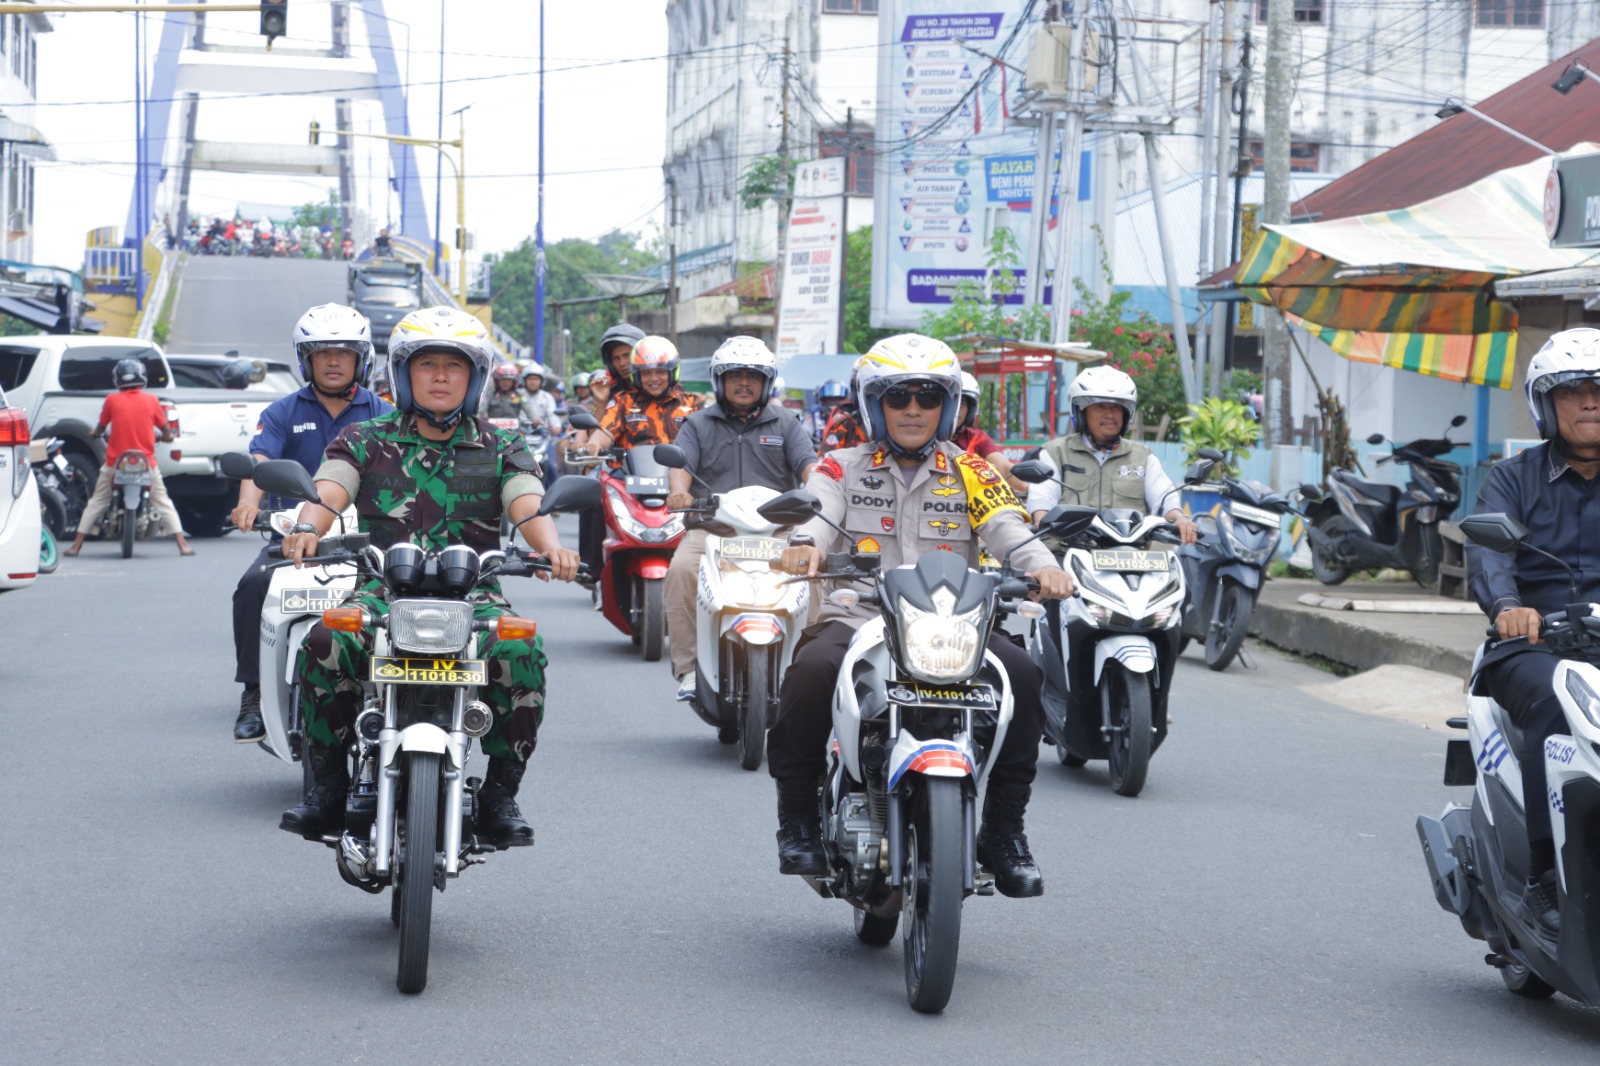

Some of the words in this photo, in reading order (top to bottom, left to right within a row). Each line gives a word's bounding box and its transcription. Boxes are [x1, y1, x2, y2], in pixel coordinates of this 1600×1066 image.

[990, 160, 1034, 174] BAYAR
[991, 176, 1012, 189] DEMI
[851, 495, 895, 508] DODY
[967, 496, 984, 517] KA
[759, 541, 773, 549] IV
[1132, 551, 1147, 560] IV
[699, 566, 715, 603] POLISI
[327, 590, 345, 599] IV
[433, 660, 456, 670] IV
[409, 670, 482, 683] 11018-30
[919, 689, 992, 703] IV-11014-30
[1545, 740, 1577, 765] POLISI
